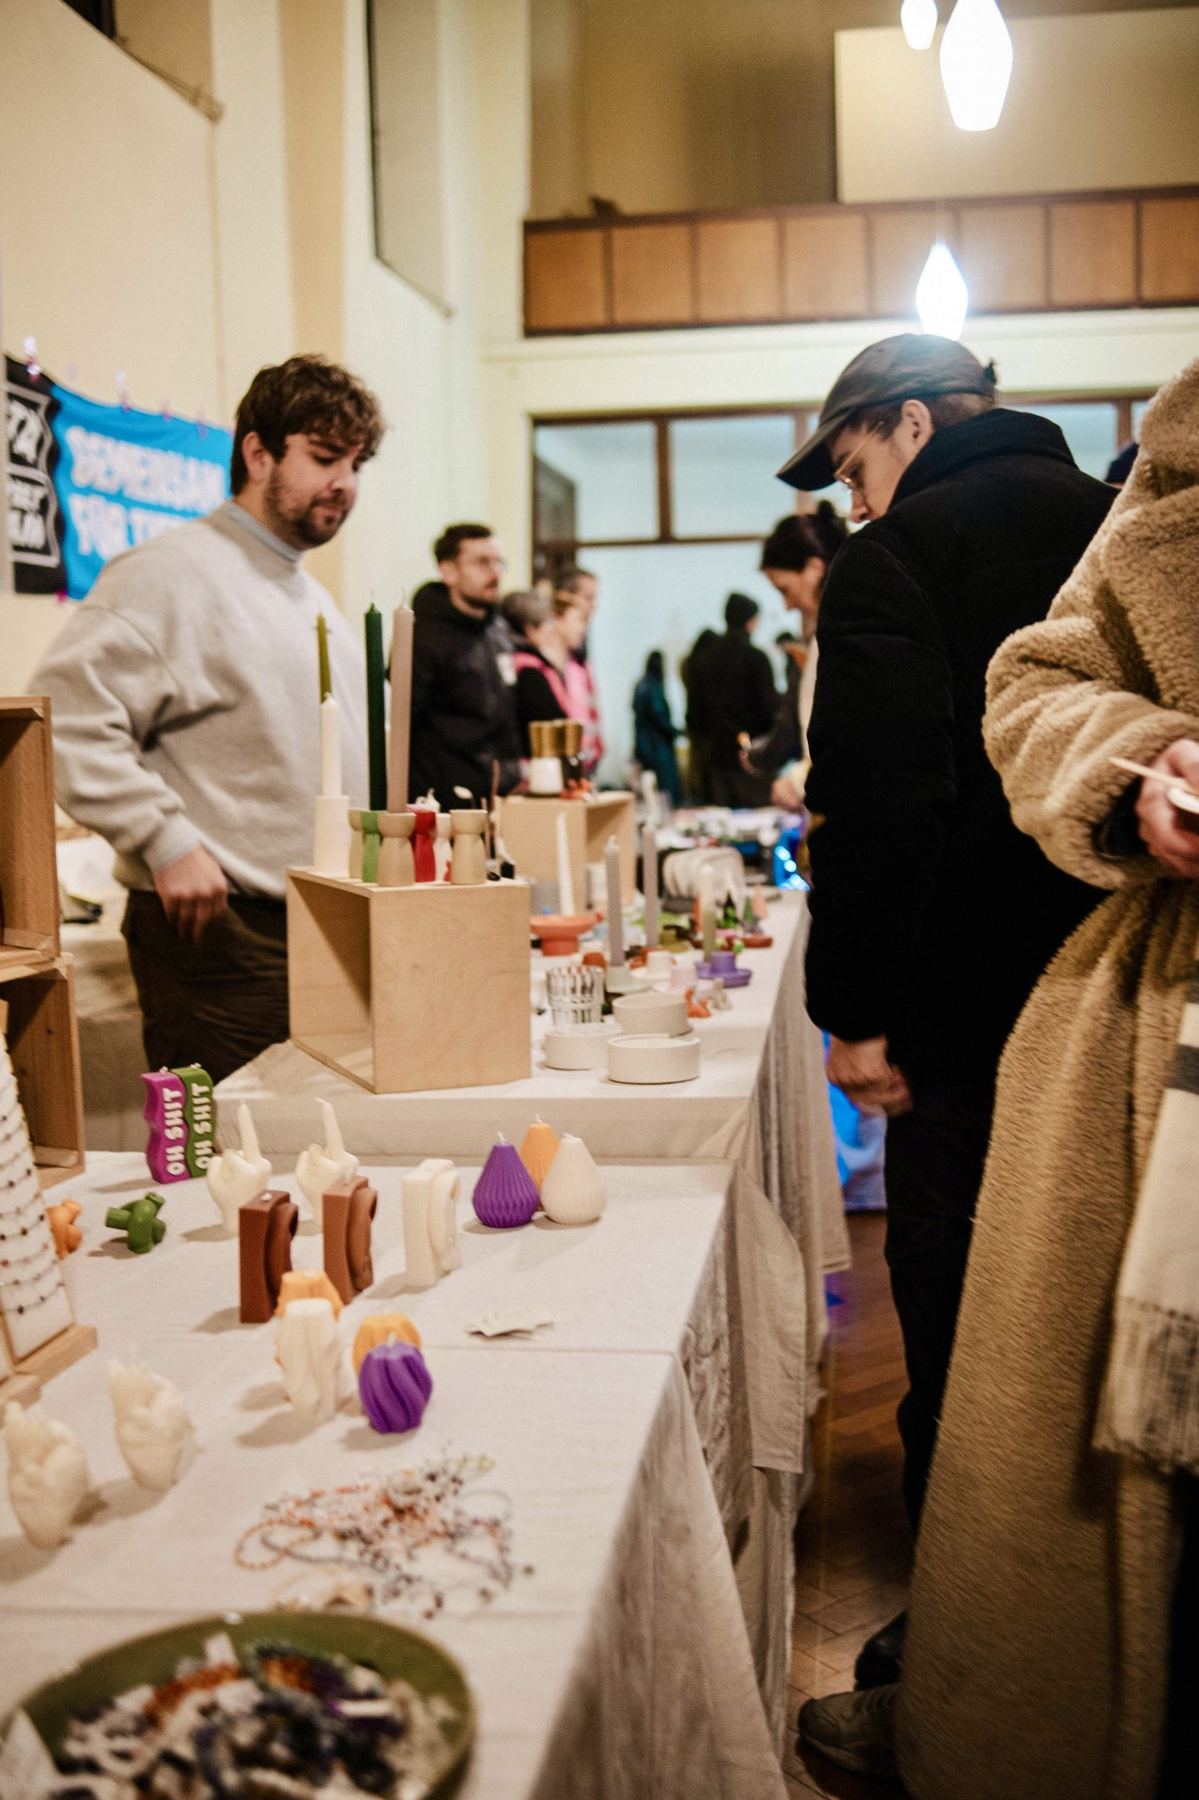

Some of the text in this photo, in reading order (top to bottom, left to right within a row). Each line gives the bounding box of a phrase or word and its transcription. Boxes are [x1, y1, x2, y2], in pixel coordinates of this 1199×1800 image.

[162, 1087, 186, 1176] OH SHIT
[191, 1082, 213, 1170] OH SHIT
